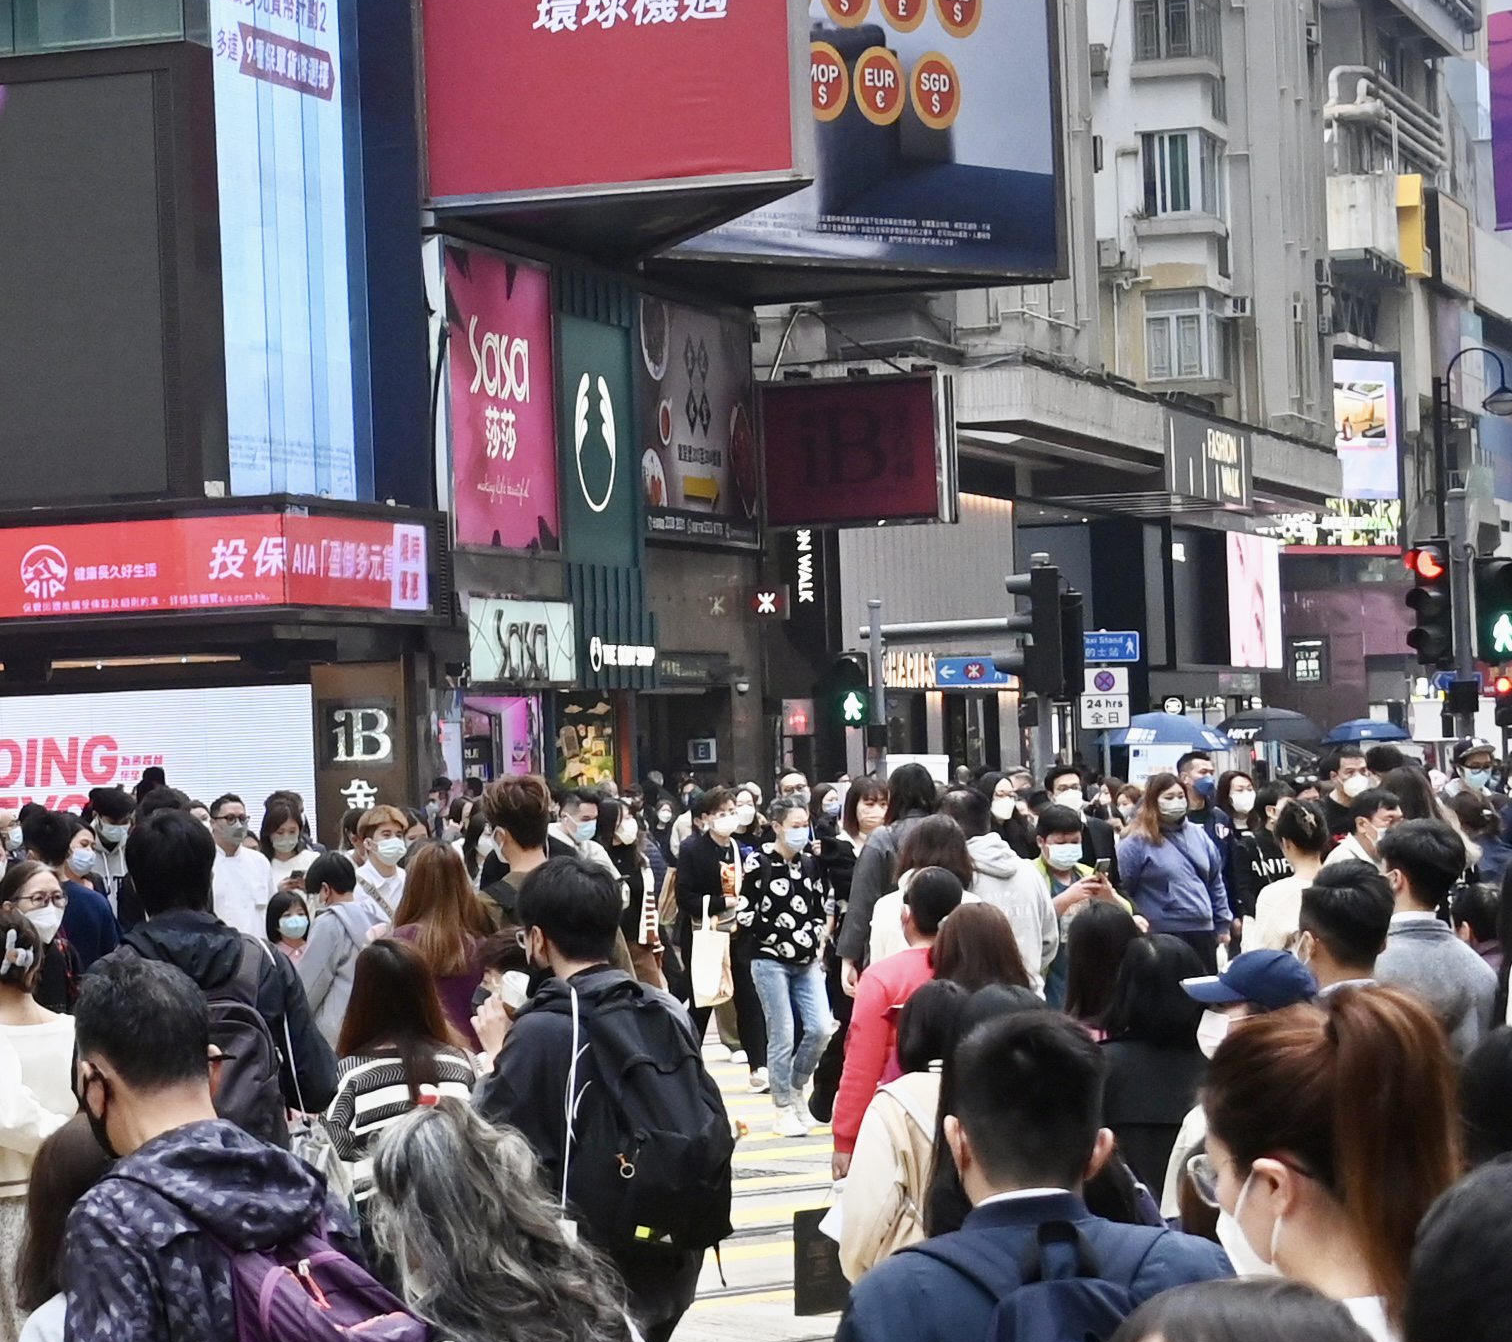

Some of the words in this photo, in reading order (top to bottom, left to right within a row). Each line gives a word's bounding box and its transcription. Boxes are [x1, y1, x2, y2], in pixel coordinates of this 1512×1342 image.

[864, 67, 895, 90] EUR
[920, 71, 950, 94] SGD
[484, 404, 517, 462] 莎莎
[1206, 427, 1238, 464] FASHION
[1220, 463, 1241, 501] WALK
[209, 536, 287, 581] 投保
[73, 562, 157, 583] 健康長久好生活
[797, 553, 814, 603] WALK
[1086, 699, 1103, 710] 24
[1105, 698, 1125, 710] hrs
[1090, 710, 1121, 726] 全日
[1226, 728, 1258, 740] HKT
